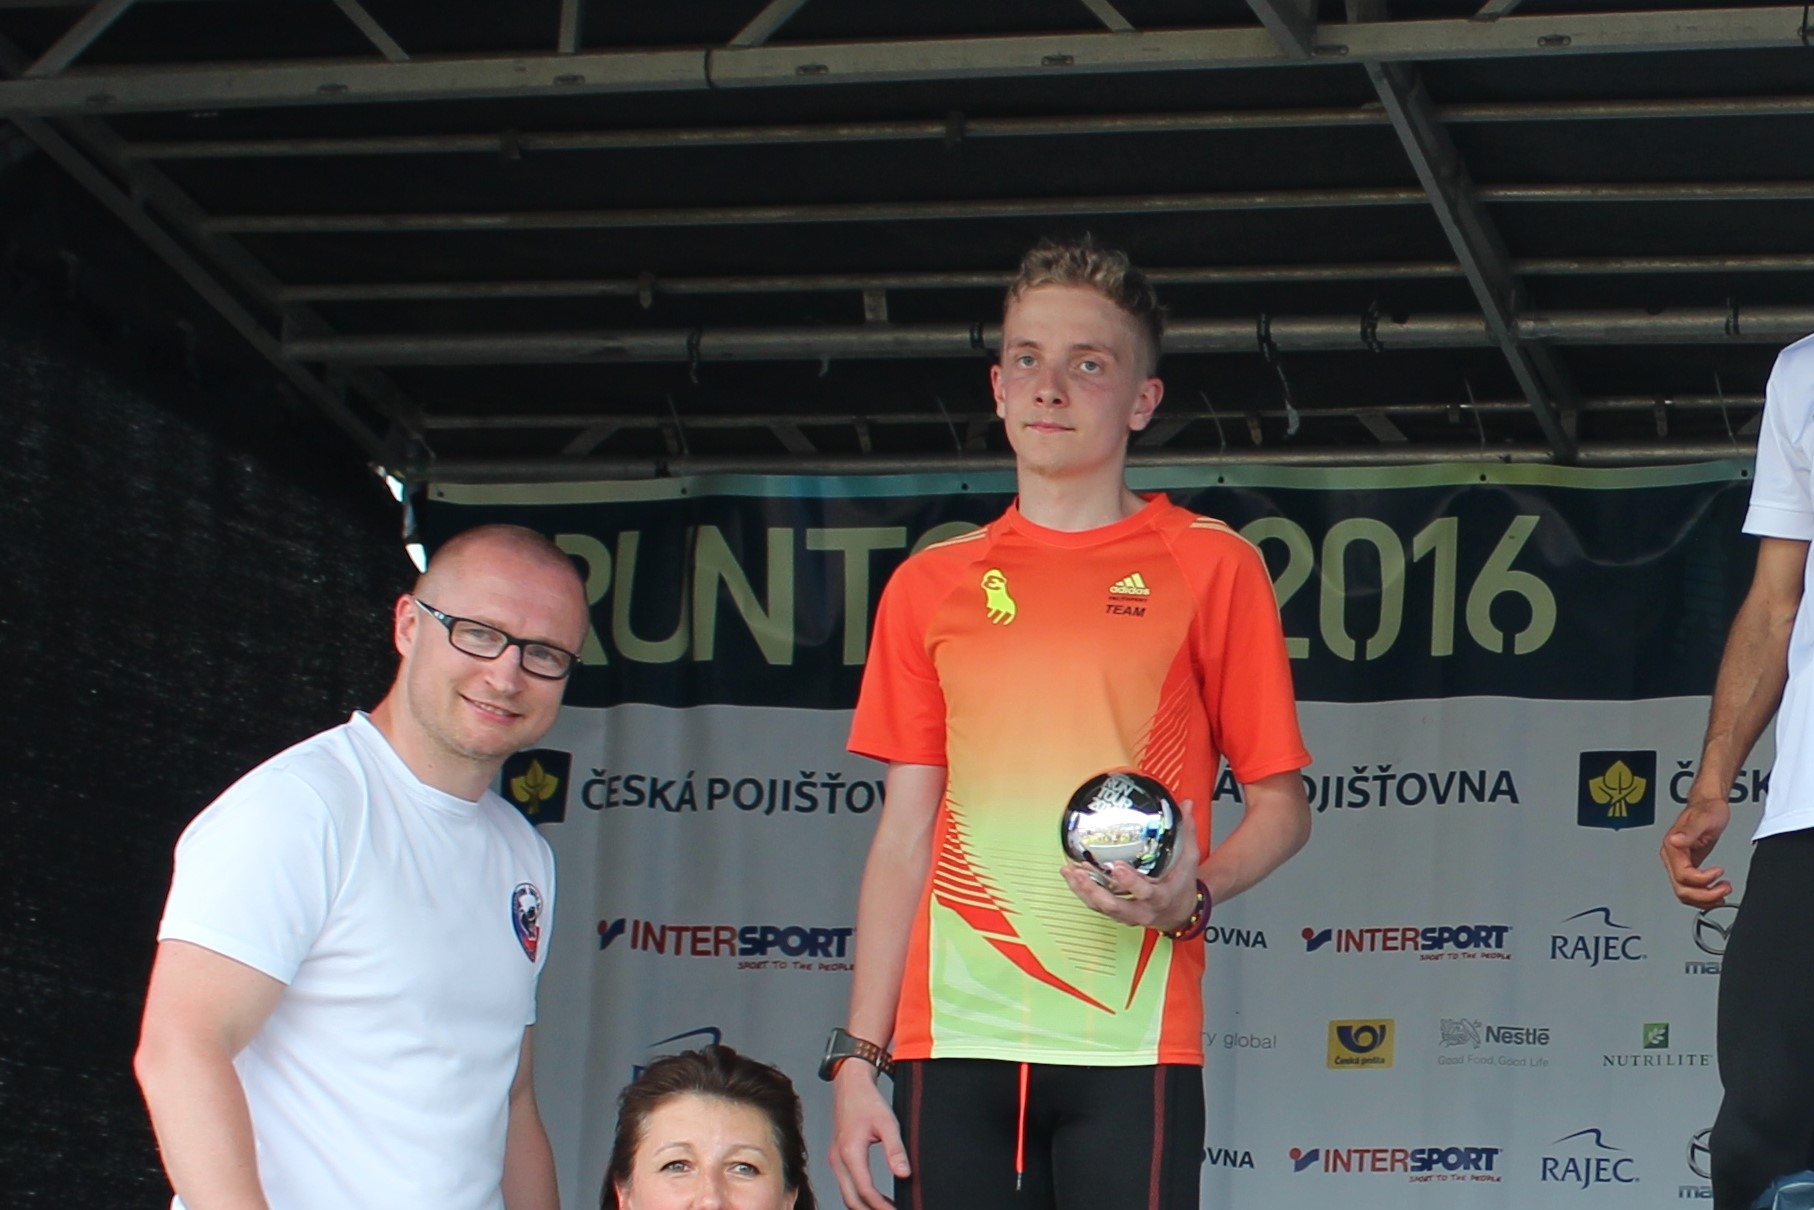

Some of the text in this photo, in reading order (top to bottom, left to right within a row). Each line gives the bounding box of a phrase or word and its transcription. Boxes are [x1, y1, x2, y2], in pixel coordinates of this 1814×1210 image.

[1109, 585, 1151, 596] adidas
[1105, 604, 1147, 618] TEAM
[581, 758, 700, 814] ČESKÁ
[630, 918, 854, 960] INTERSPORT
[1335, 924, 1509, 954] INTERSPORT
[1551, 934, 1643, 967] RAJEC
[1223, 1031, 1277, 1050] global
[1438, 1054, 1464, 1066] Good
[1498, 1055, 1526, 1067] Good
[1530, 1056, 1549, 1067] Life
[1602, 1054, 1710, 1068] NUTRILITE
[1324, 1147, 1498, 1174] INTERSPORT
[1540, 1157, 1635, 1190] RAJEC
